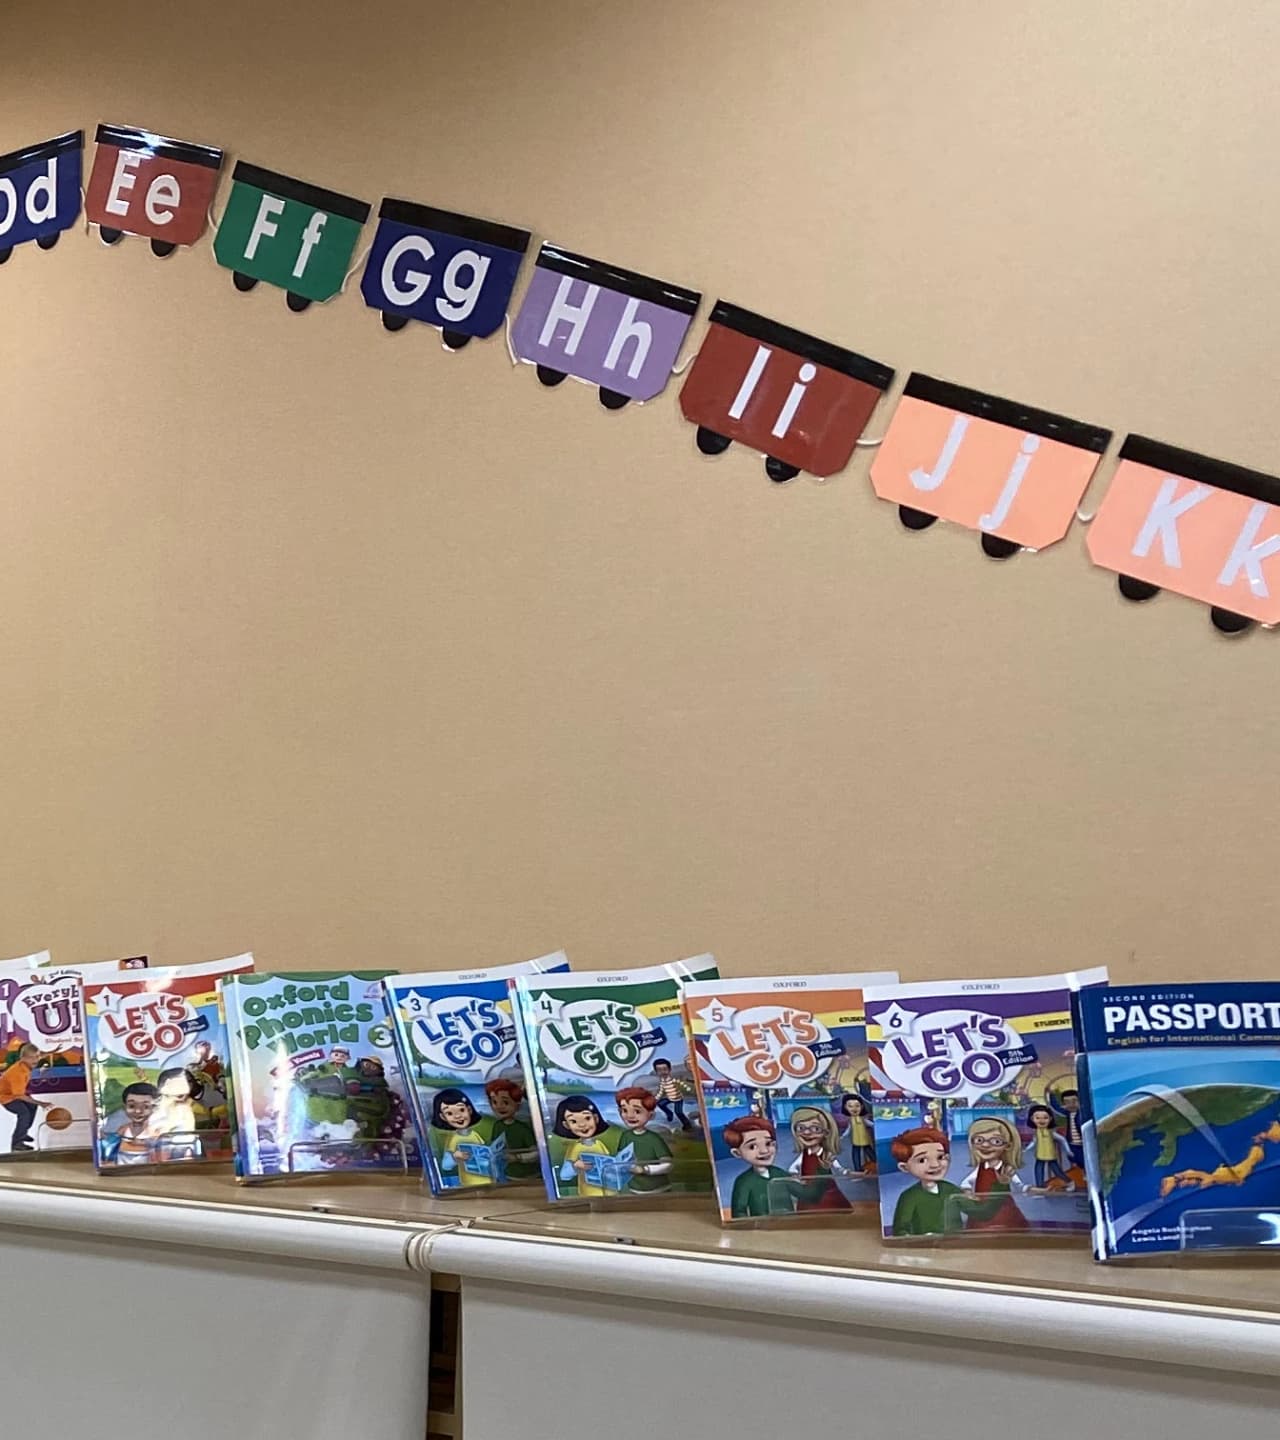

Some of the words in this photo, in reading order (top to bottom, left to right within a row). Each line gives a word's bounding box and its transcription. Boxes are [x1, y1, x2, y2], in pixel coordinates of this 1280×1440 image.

[104, 149, 183, 226] Ee
[244, 195, 328, 279] Ff
[380, 235, 492, 323] Gg
[538, 276, 654, 380] Hh
[728, 345, 818, 439] Ii
[908, 415, 1040, 531] Jj
[1, 983, 10, 997] 1
[103, 995, 110, 1007] 1
[243, 981, 350, 1017] Oxford
[410, 998, 422, 1013] 3
[540, 998, 554, 1015] 4
[1102, 994, 1146, 1003] SECOND
[104, 994, 187, 1035] LET'S
[237, 1001, 374, 1050] Phonics
[417, 999, 501, 1043] LET'S
[546, 1002, 640, 1048] LET'S
[711, 1007, 724, 1023] 5
[716, 1010, 818, 1058] LET'S
[889, 1012, 903, 1029] 6
[125, 1024, 183, 1058] GO
[374, 1027, 393, 1047] 3
[443, 1032, 503, 1066] GO
[572, 1036, 639, 1072] GO
[891, 1014, 1007, 1066] LET'S
[1107, 1035, 1148, 1047] English
[1149, 1034, 1166, 1043] for
[1167, 1033, 1237, 1043] International
[744, 1044, 816, 1084] GO
[921, 1052, 1002, 1092] GO
